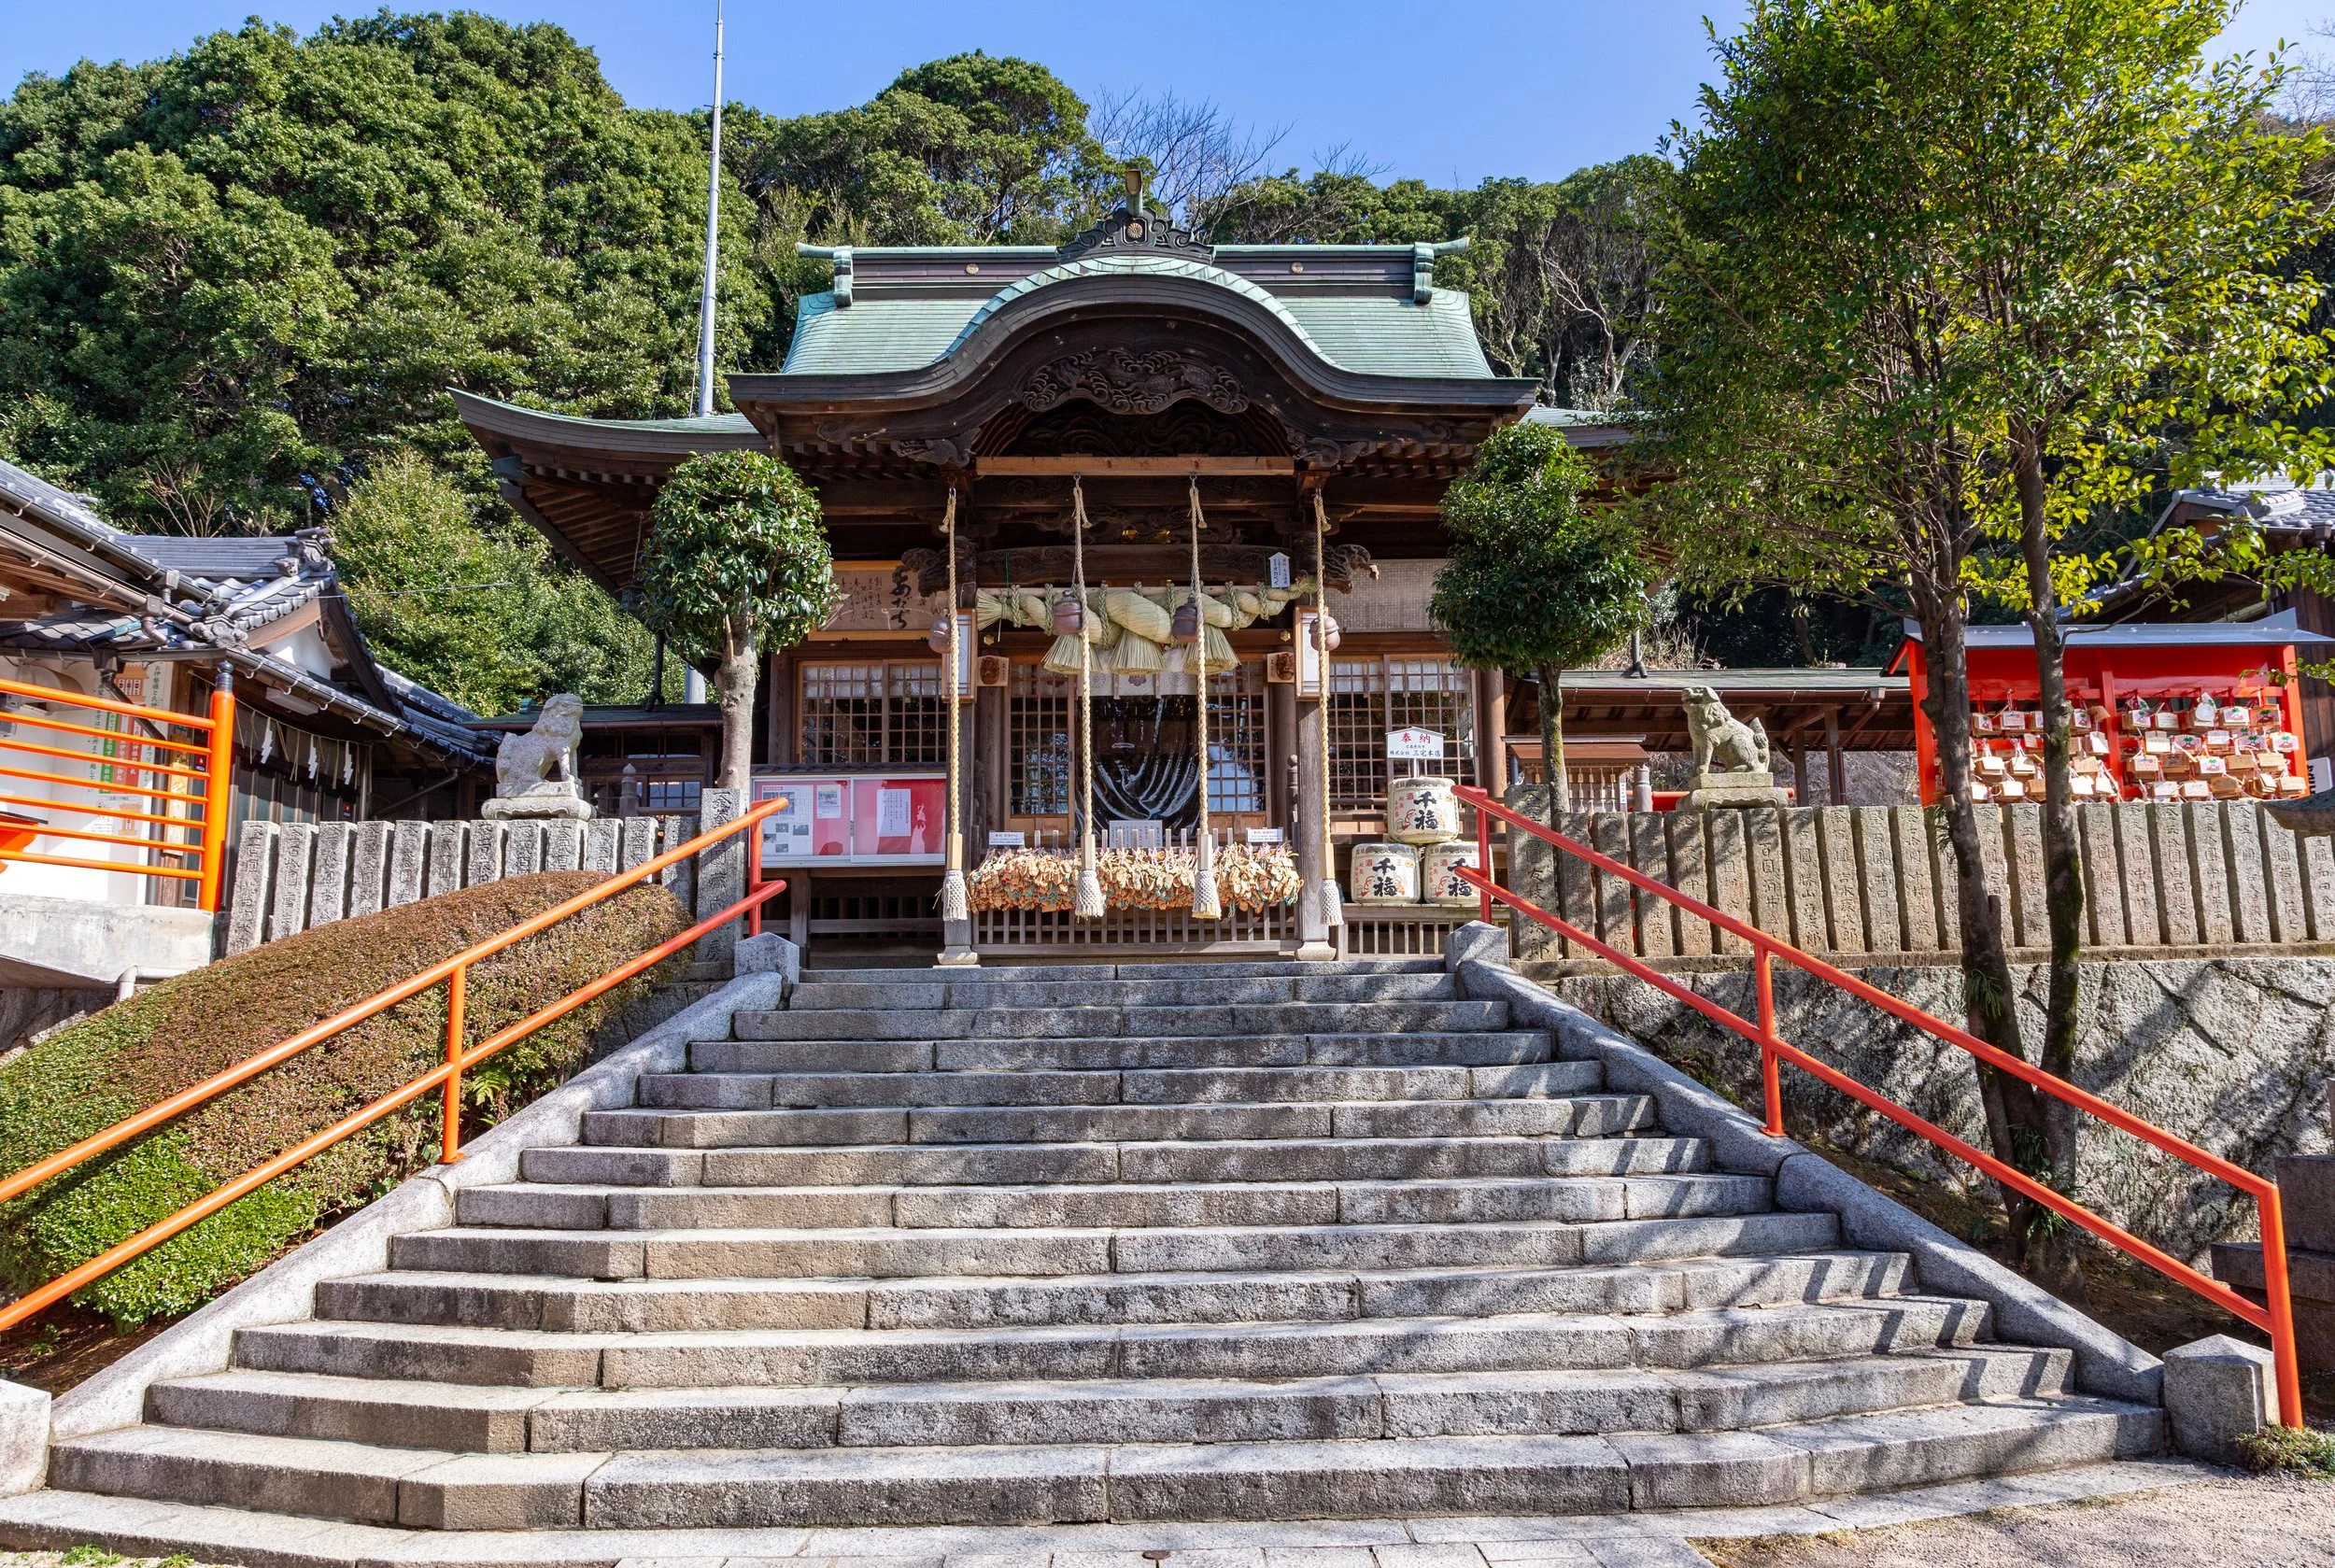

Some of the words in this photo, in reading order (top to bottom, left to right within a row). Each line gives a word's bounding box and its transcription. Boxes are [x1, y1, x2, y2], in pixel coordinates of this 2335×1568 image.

[1401, 732, 1431, 744] 奉納
[1413, 791, 1438, 830] 千福
[1372, 857, 1398, 897] 千福
